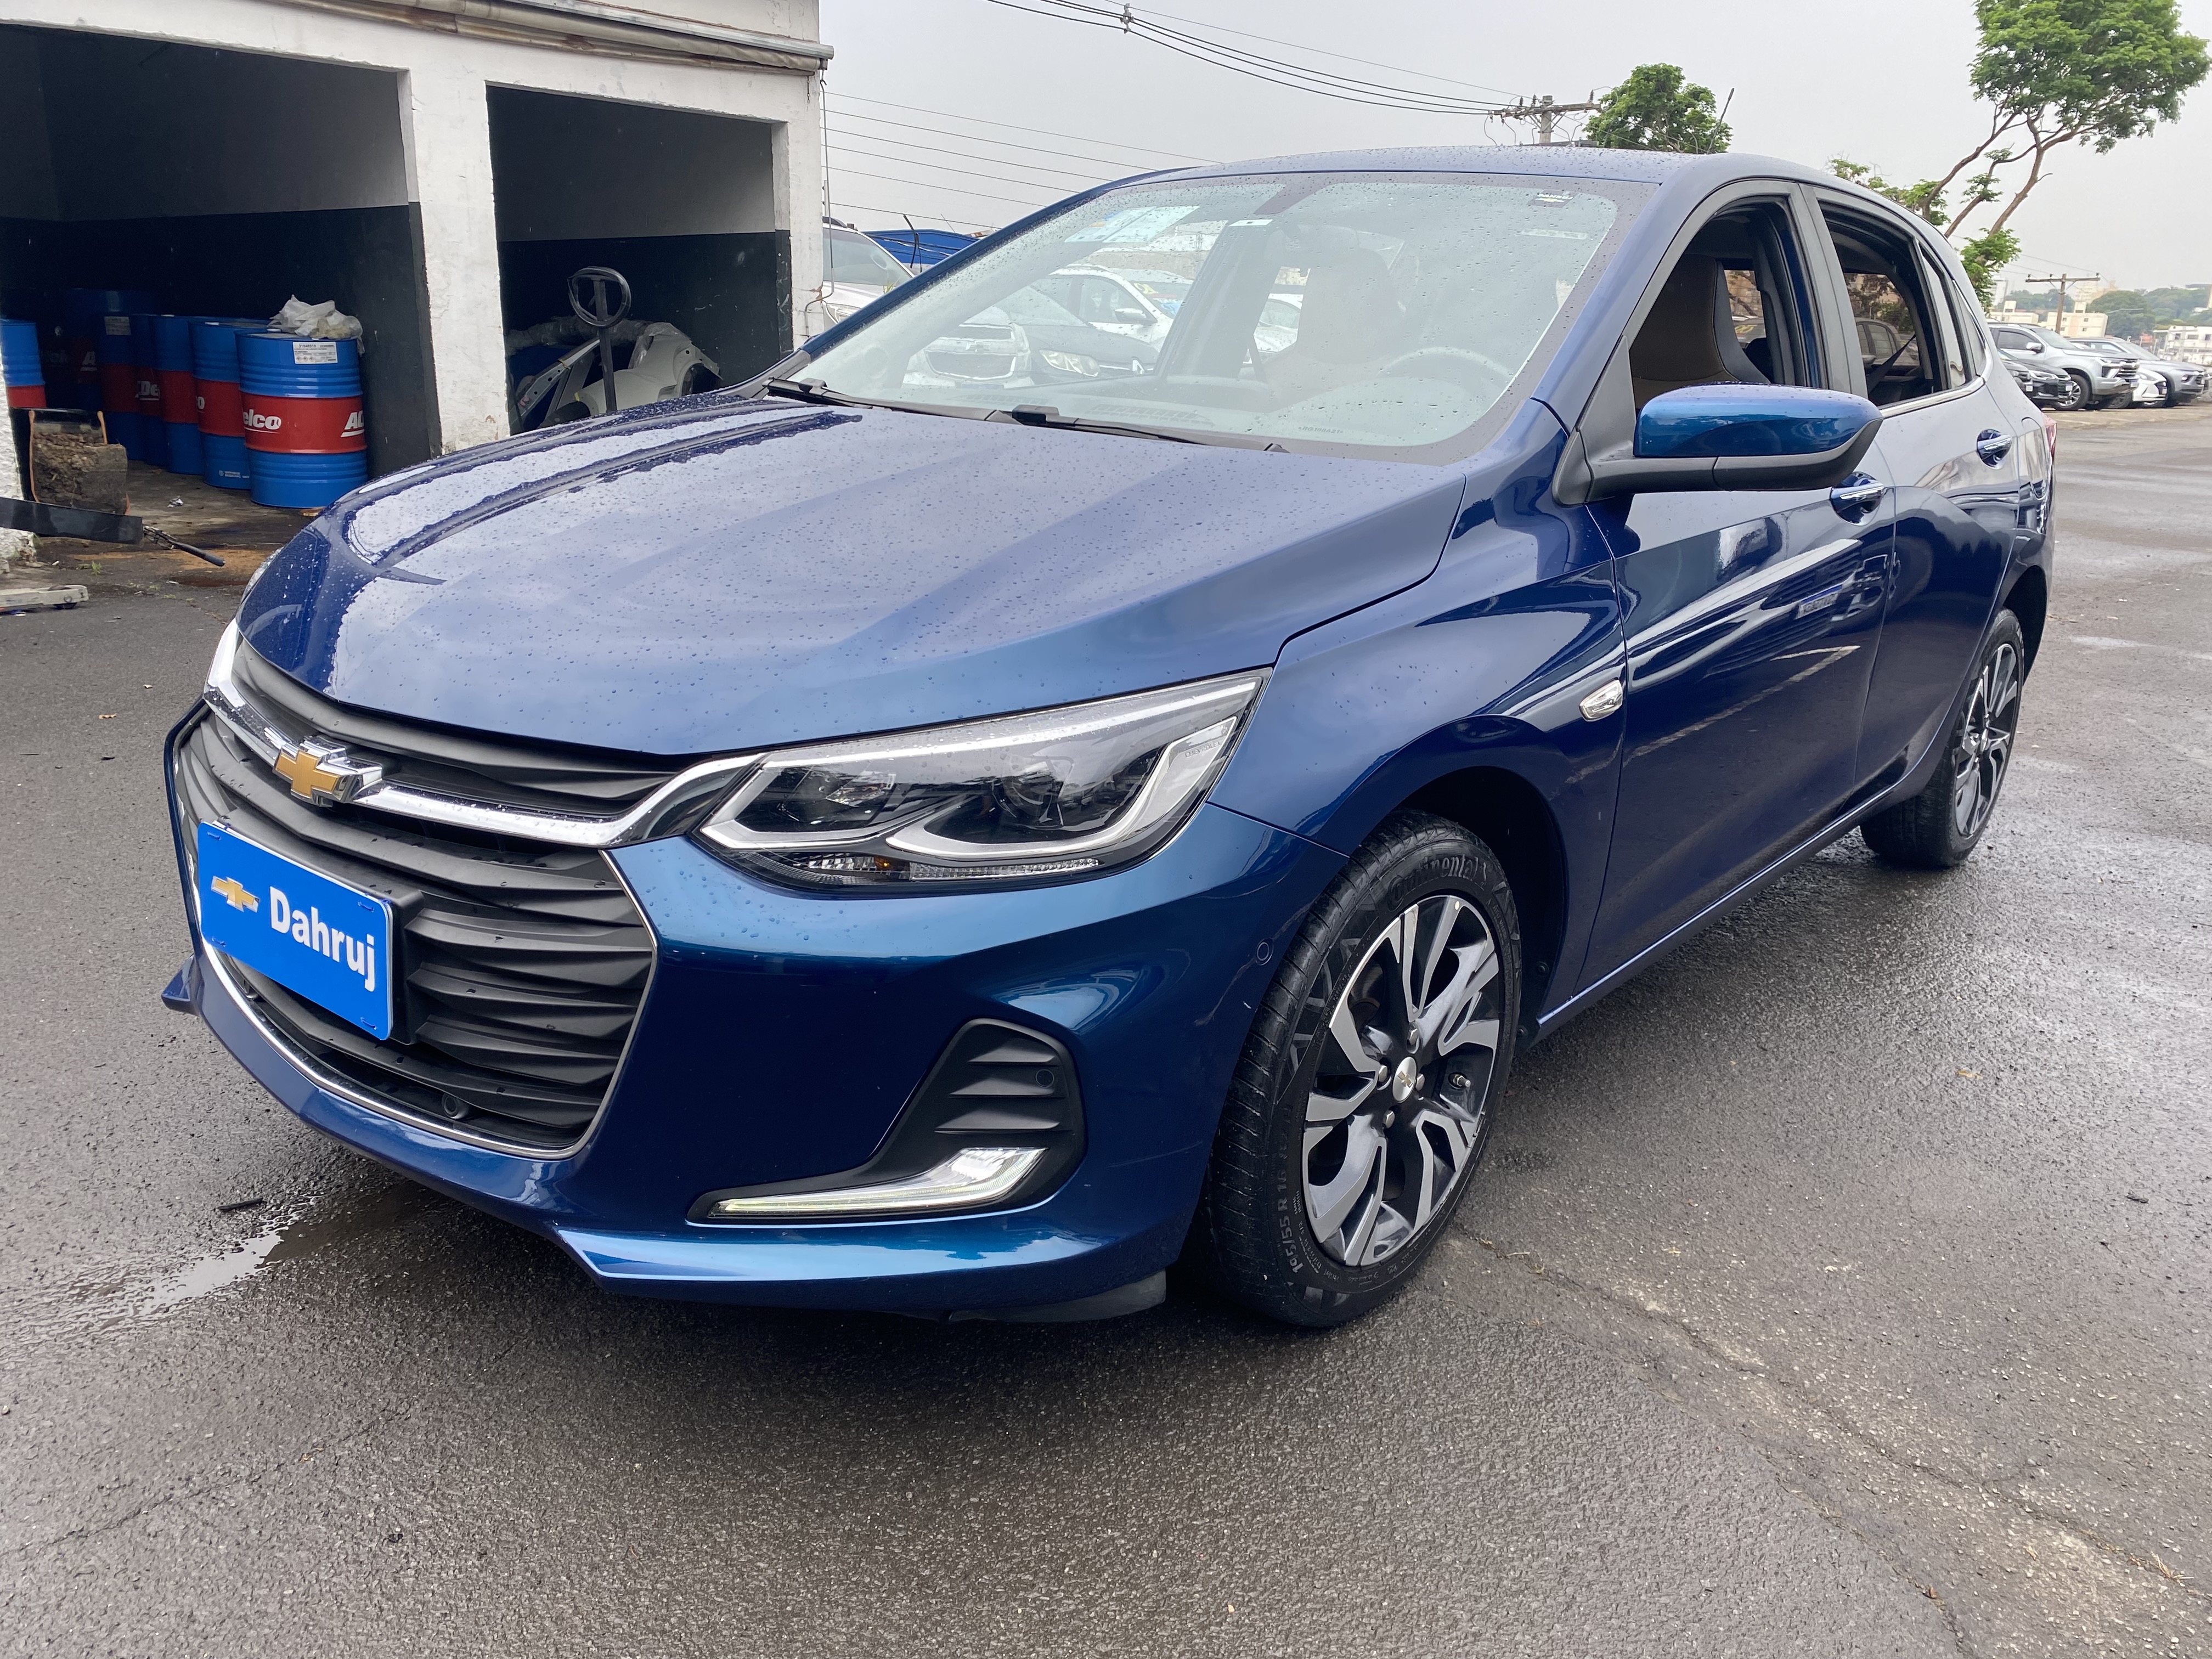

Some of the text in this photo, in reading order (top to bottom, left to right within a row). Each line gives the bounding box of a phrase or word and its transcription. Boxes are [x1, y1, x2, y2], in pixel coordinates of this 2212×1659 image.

[1185, 741, 1220, 758] CHEVROLET
[1386, 854, 1479, 912] Continental
[269, 885, 375, 992] Dahruj
[1277, 1197, 1289, 1211] R
[1279, 1215, 1304, 1273] 195/55
